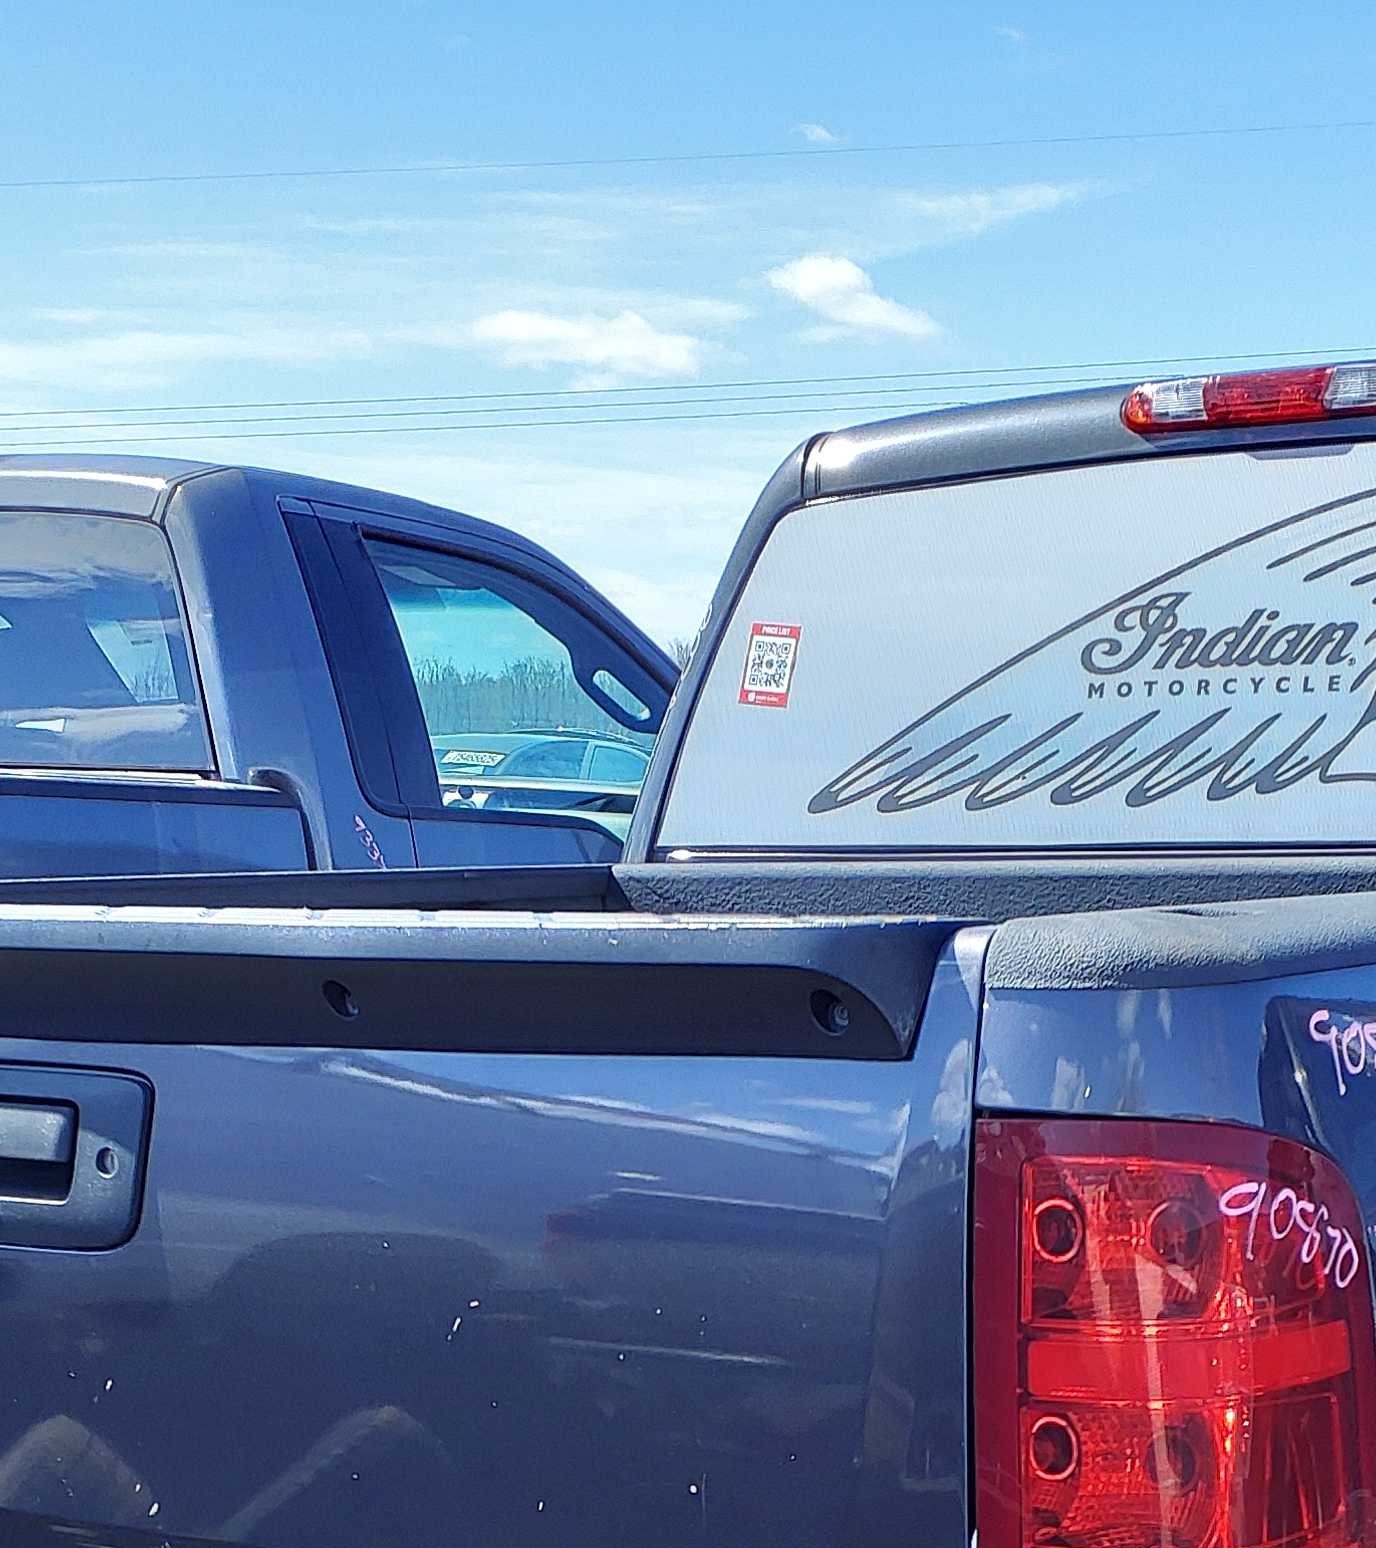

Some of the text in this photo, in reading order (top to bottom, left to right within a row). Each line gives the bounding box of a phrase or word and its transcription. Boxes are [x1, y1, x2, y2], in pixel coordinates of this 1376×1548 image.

[1080, 591, 1359, 675] Indian
[1086, 674, 1342, 700] MOTORCYCLE
[1218, 1181, 1360, 1289] 90870
